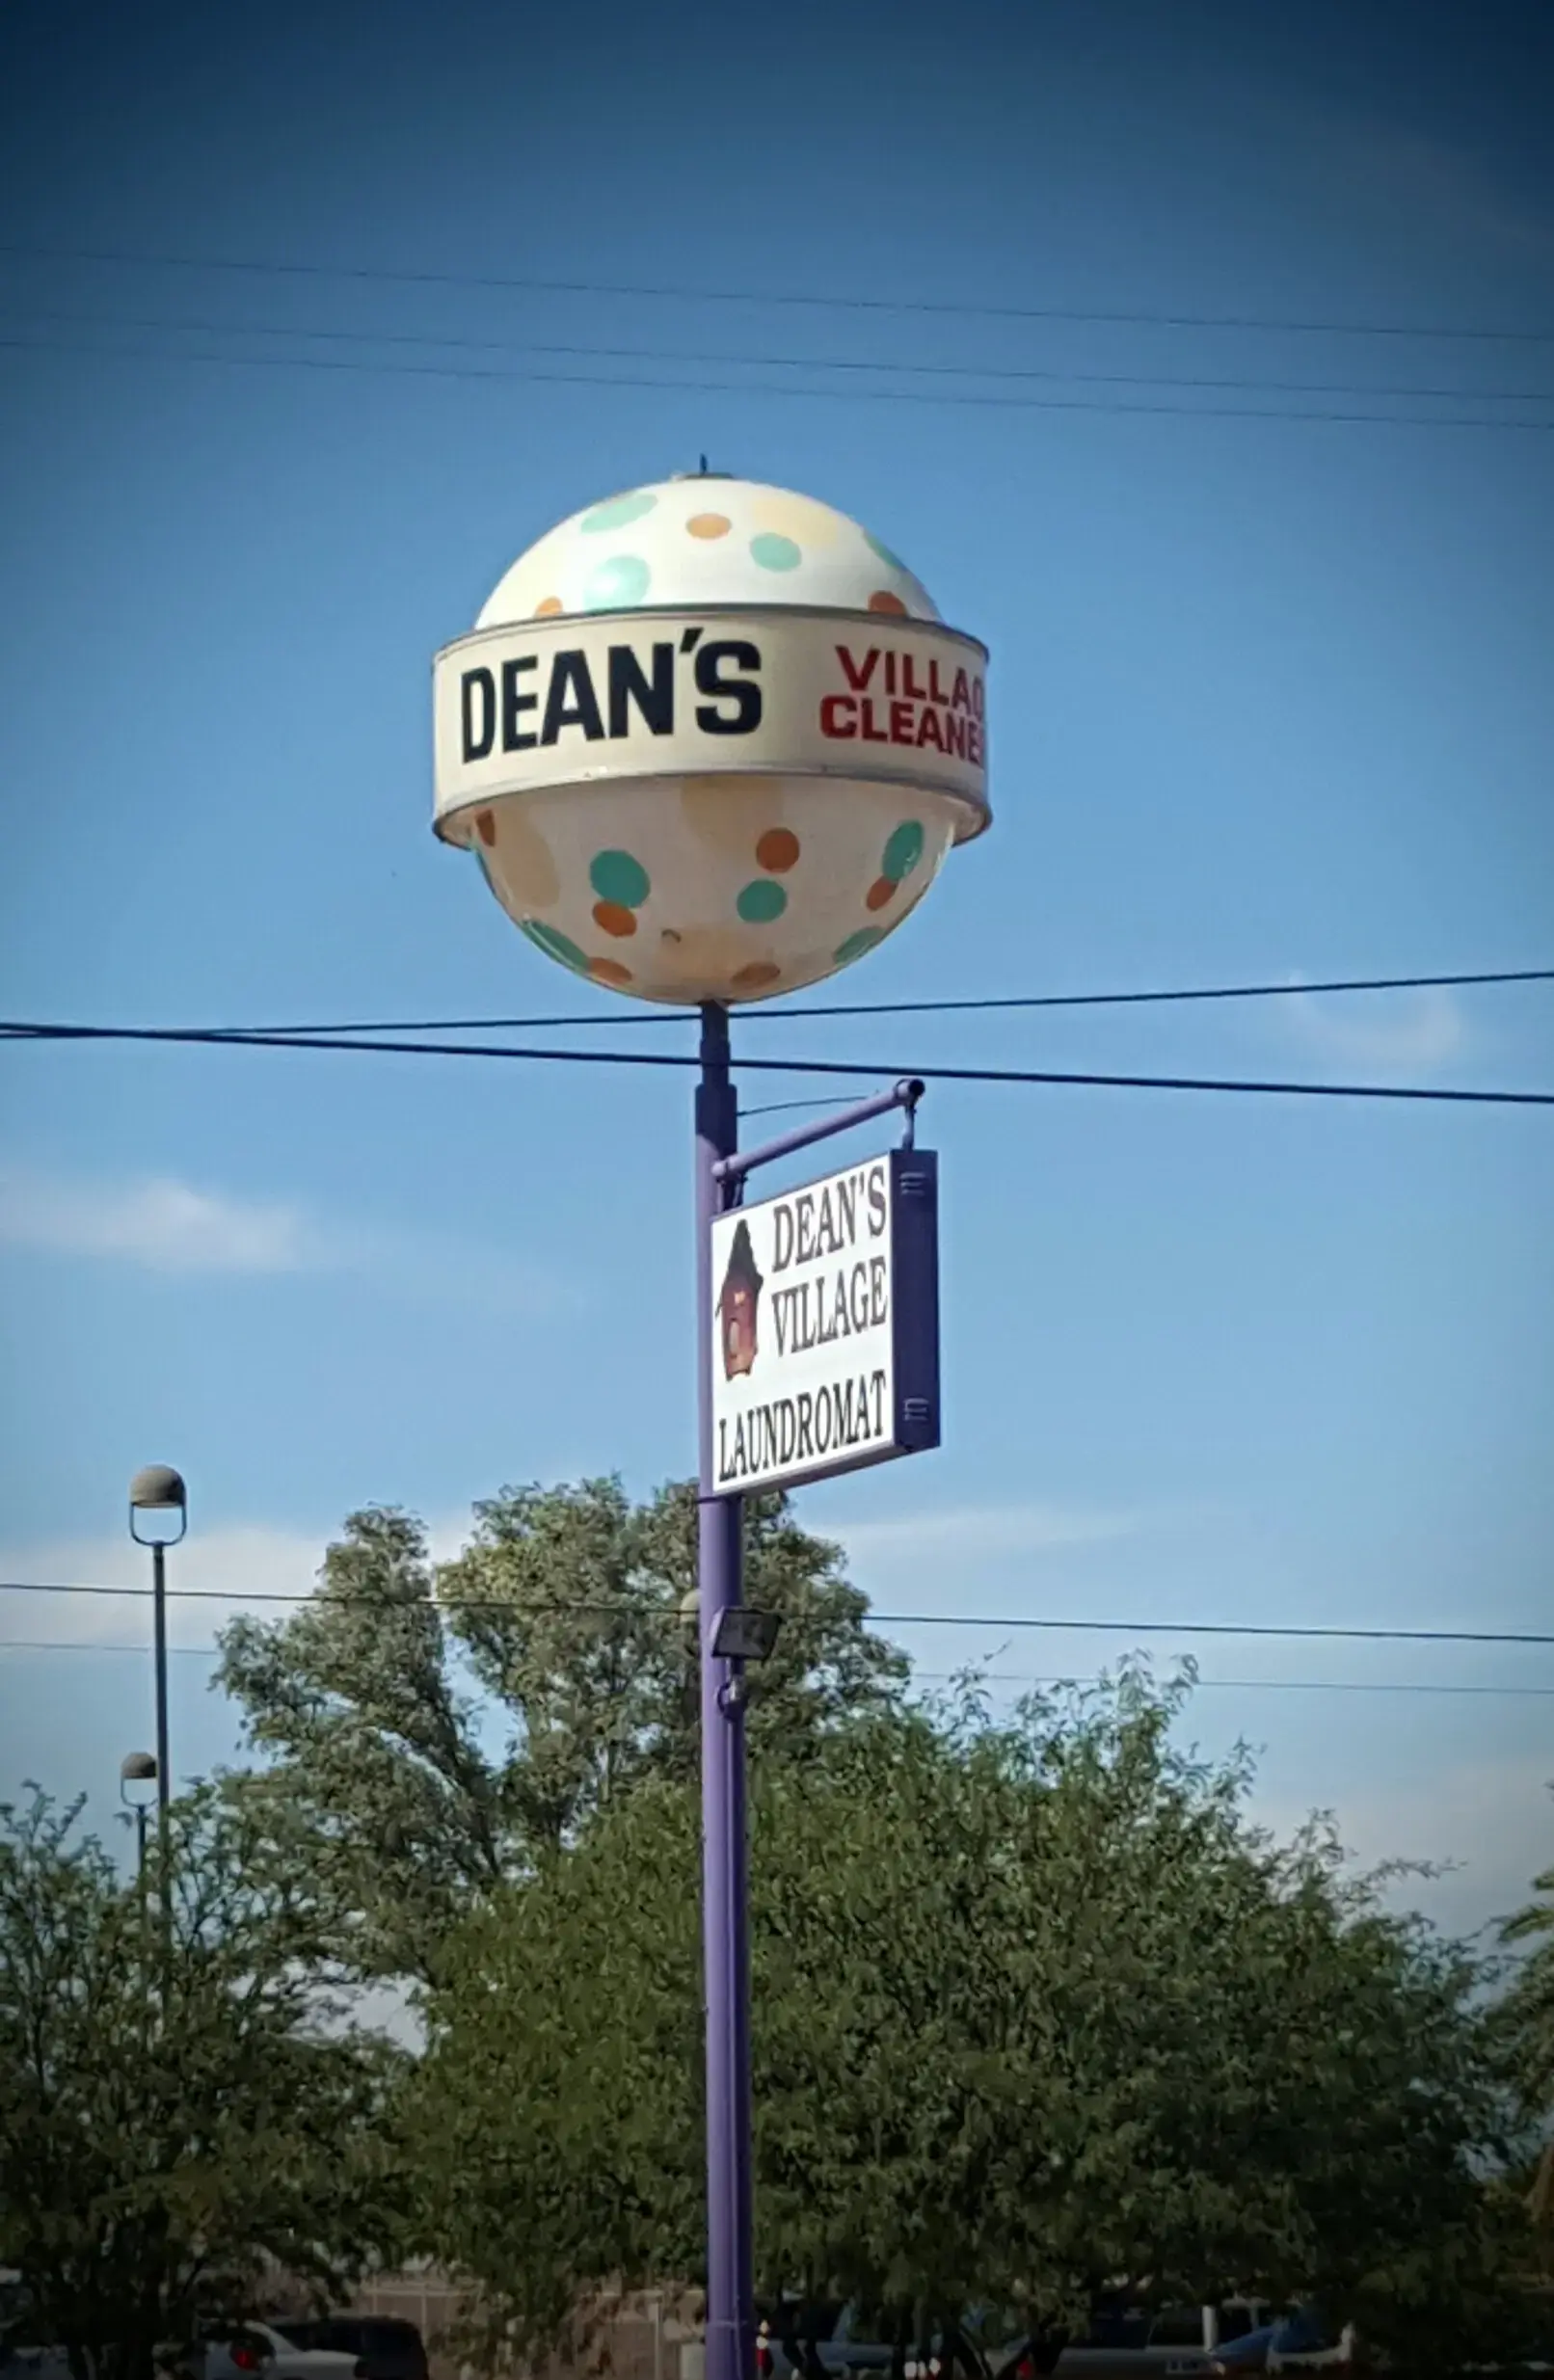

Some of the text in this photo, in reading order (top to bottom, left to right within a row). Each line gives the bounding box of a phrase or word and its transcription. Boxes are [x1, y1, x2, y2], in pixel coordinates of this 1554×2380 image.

[461, 628, 763, 763] DEAN'S
[772, 1165, 886, 1272] DEAN'S
[772, 1255, 888, 1356] VILLAGE
[718, 1370, 886, 1482] LAUNDROMAT
